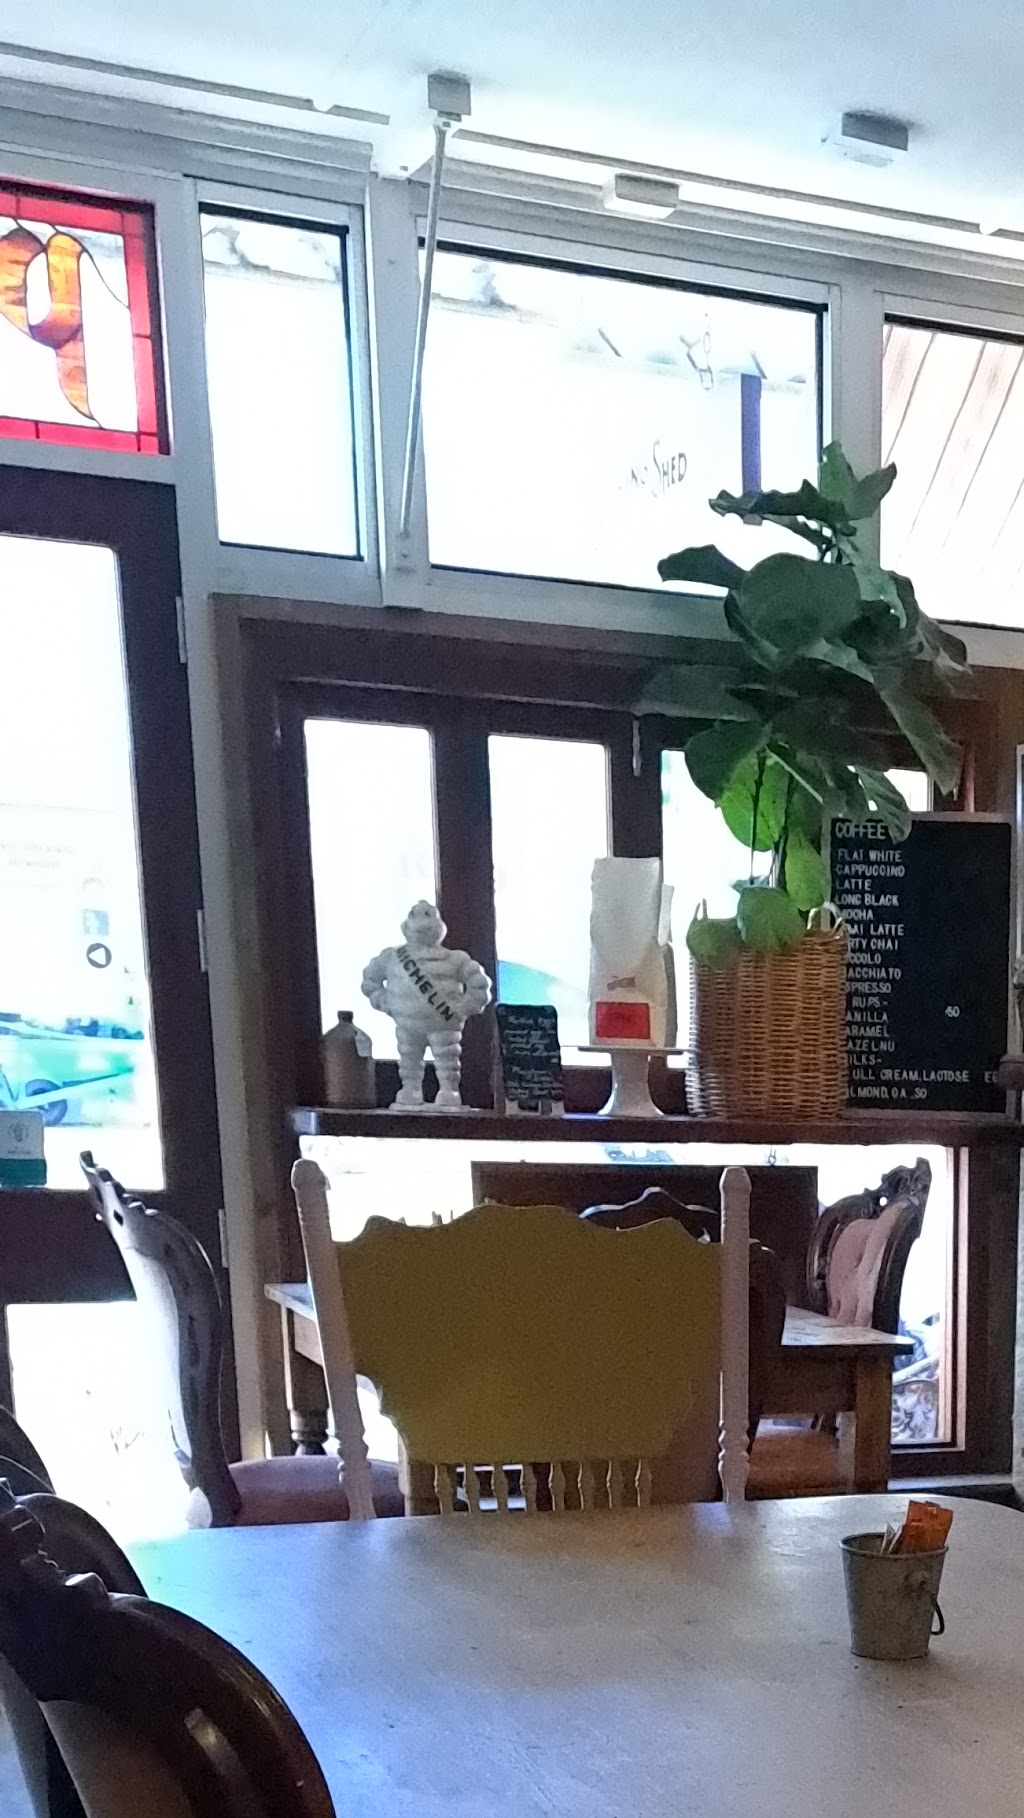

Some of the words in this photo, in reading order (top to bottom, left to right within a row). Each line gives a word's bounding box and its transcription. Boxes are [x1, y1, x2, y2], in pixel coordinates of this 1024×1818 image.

[835, 822, 887, 839] COFFEE
[837, 848, 864, 861] FLAT
[868, 849, 902, 862] WHITE
[836, 878, 872, 891] LATTE
[864, 893, 899, 906] BLACK
[870, 923, 904, 936] LATTE
[870, 938, 898, 950] CHAI
[849, 952, 882, 965] CCOLO
[847, 967, 902, 980] ACCHIATO
[397, 946, 453, 1022] MICHELIN
[844, 981, 892, 994] SPRESSO
[845, 1009, 889, 1023] ANILLA
[845, 1024, 890, 1037] ARAMEL
[846, 1039, 895, 1052] AZELNU
[849, 1053, 882, 1066] ILKS-
[852, 1067, 876, 1080] ULL
